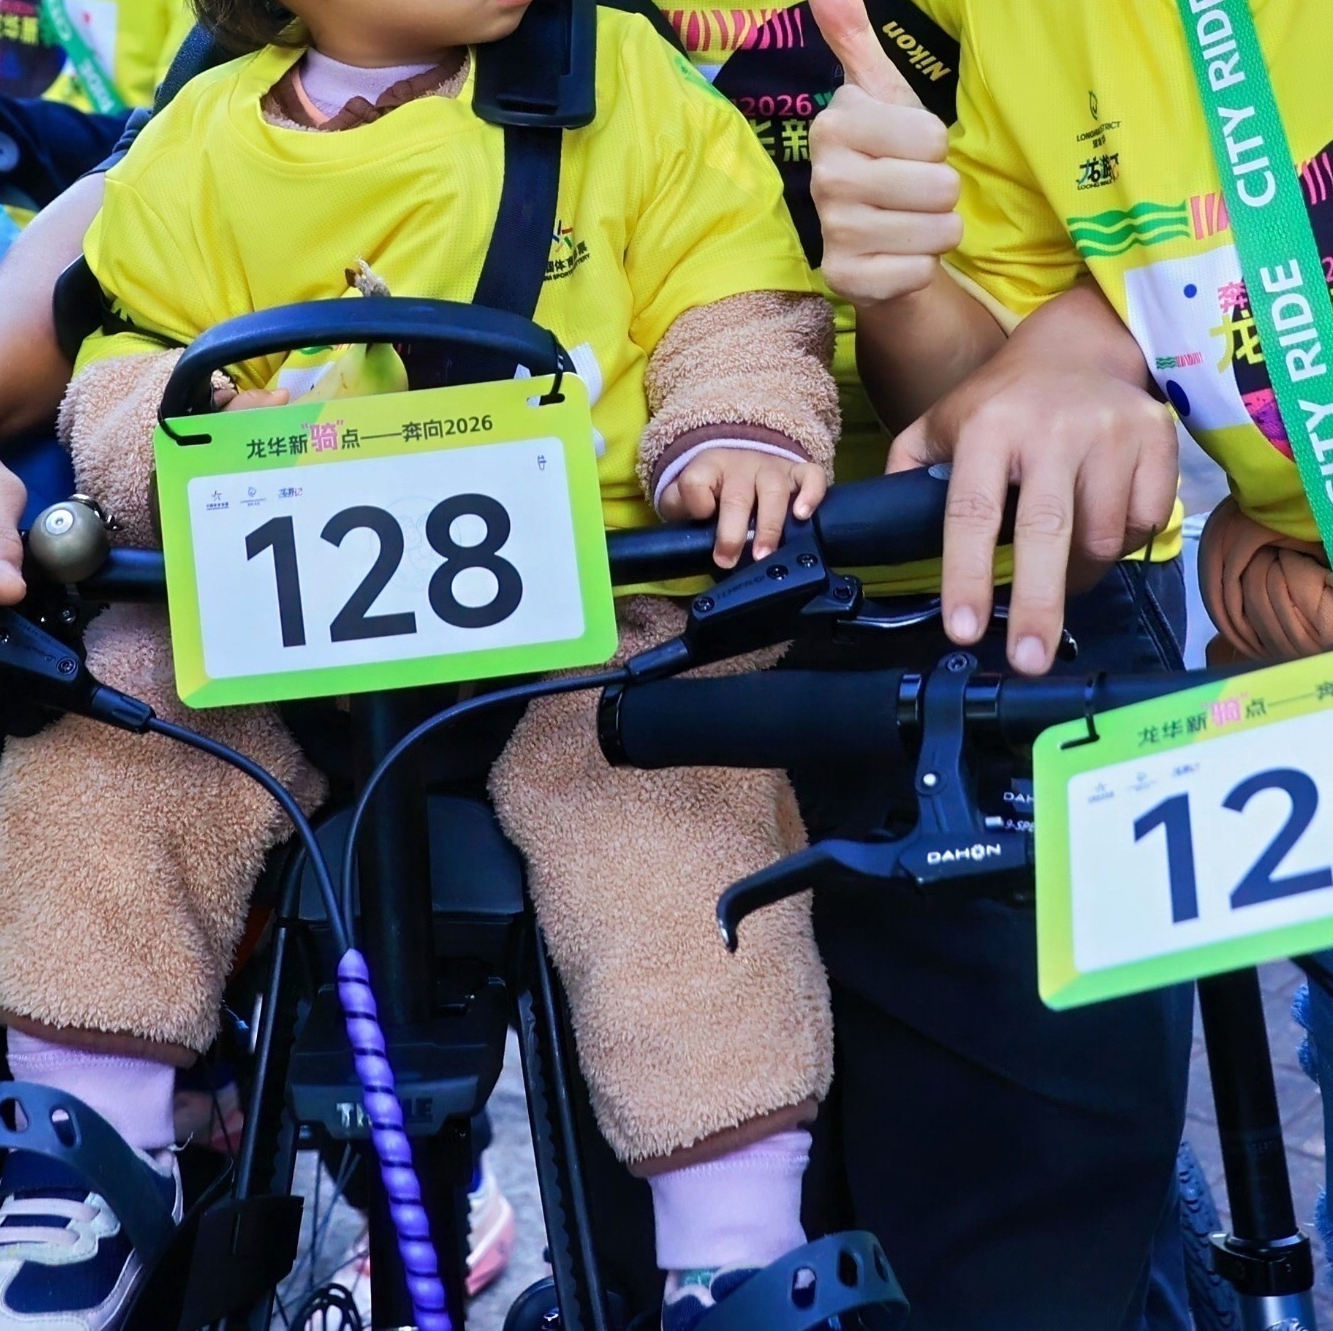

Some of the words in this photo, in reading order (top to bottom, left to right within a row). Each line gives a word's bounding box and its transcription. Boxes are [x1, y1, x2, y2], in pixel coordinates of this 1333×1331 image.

[882, 20, 952, 82] Nikon
[731, 92, 813, 117] 2026
[1217, 105, 1277, 209] CITY
[1260, 258, 1328, 383] RIDE
[245, 493, 524, 648] 128
[927, 843, 1002, 865] DAHON
